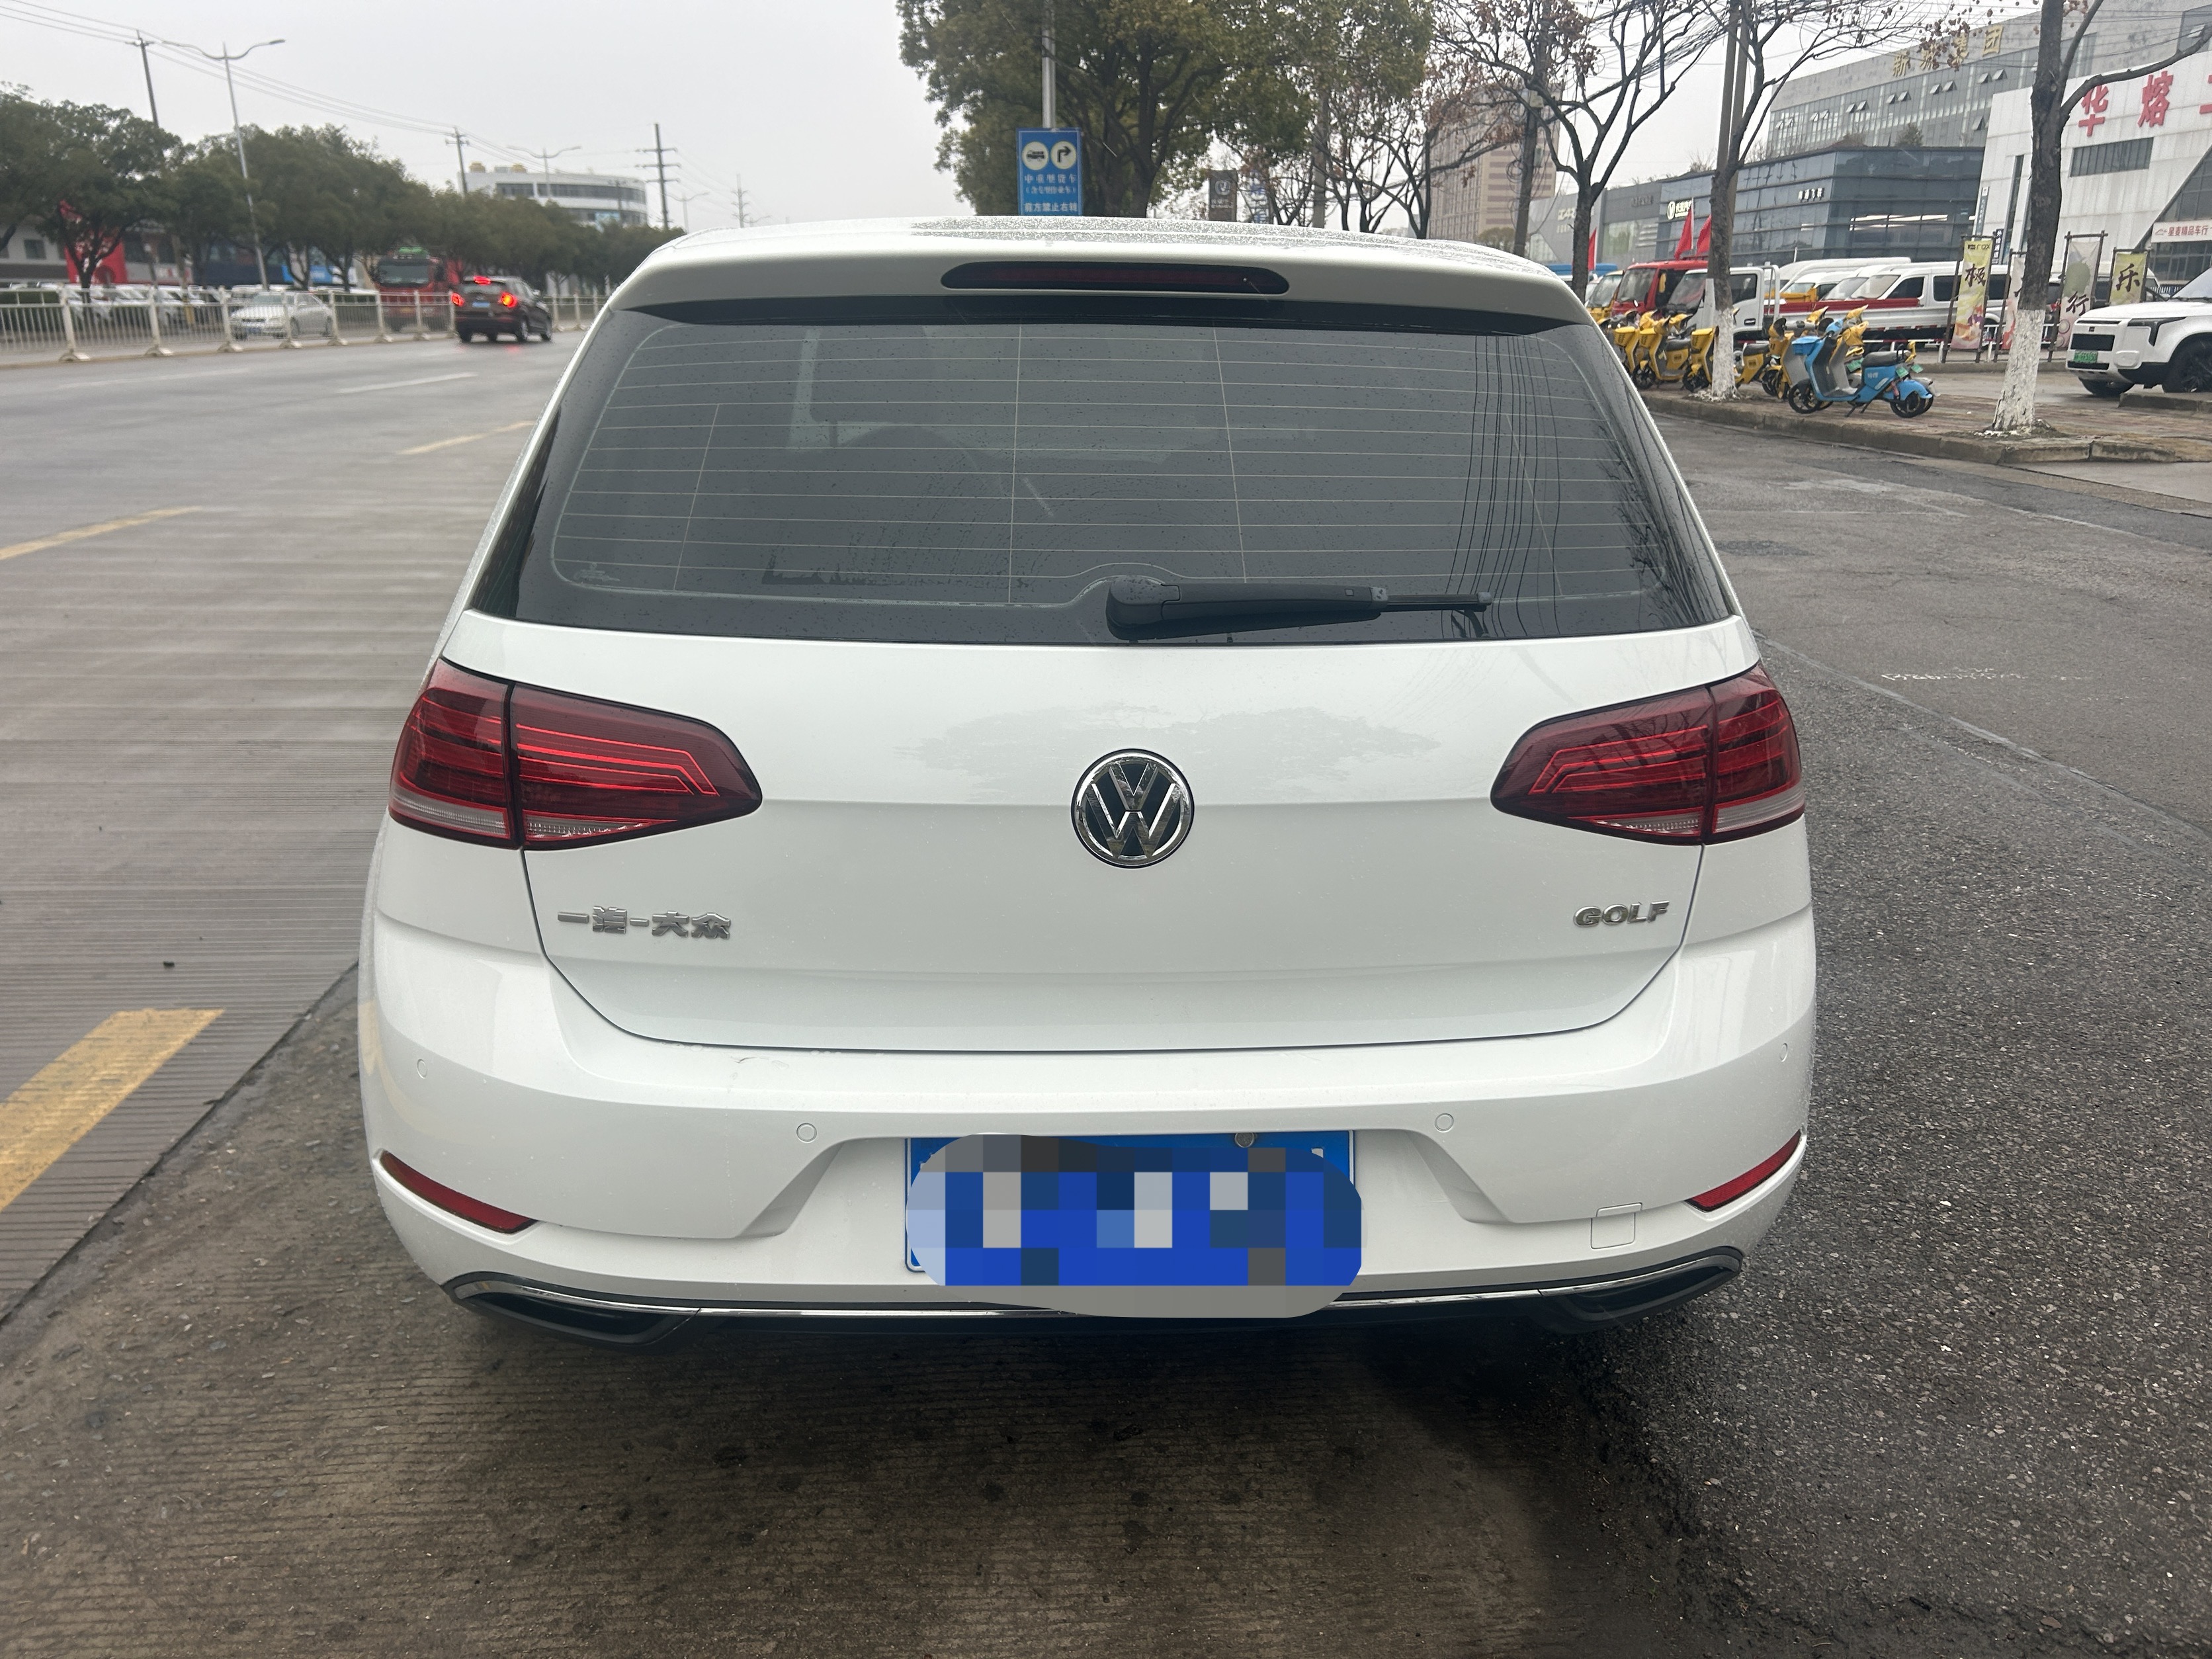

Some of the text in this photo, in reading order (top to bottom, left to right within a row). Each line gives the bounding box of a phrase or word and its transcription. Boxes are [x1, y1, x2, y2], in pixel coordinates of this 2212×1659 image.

[1024, 202, 1078, 212] 前方禁止右转
[1964, 264, 1986, 287] 极
[2115, 263, 2140, 292] 乐
[2066, 291, 2089, 316] 行
[1574, 900, 1670, 927] GOLF
